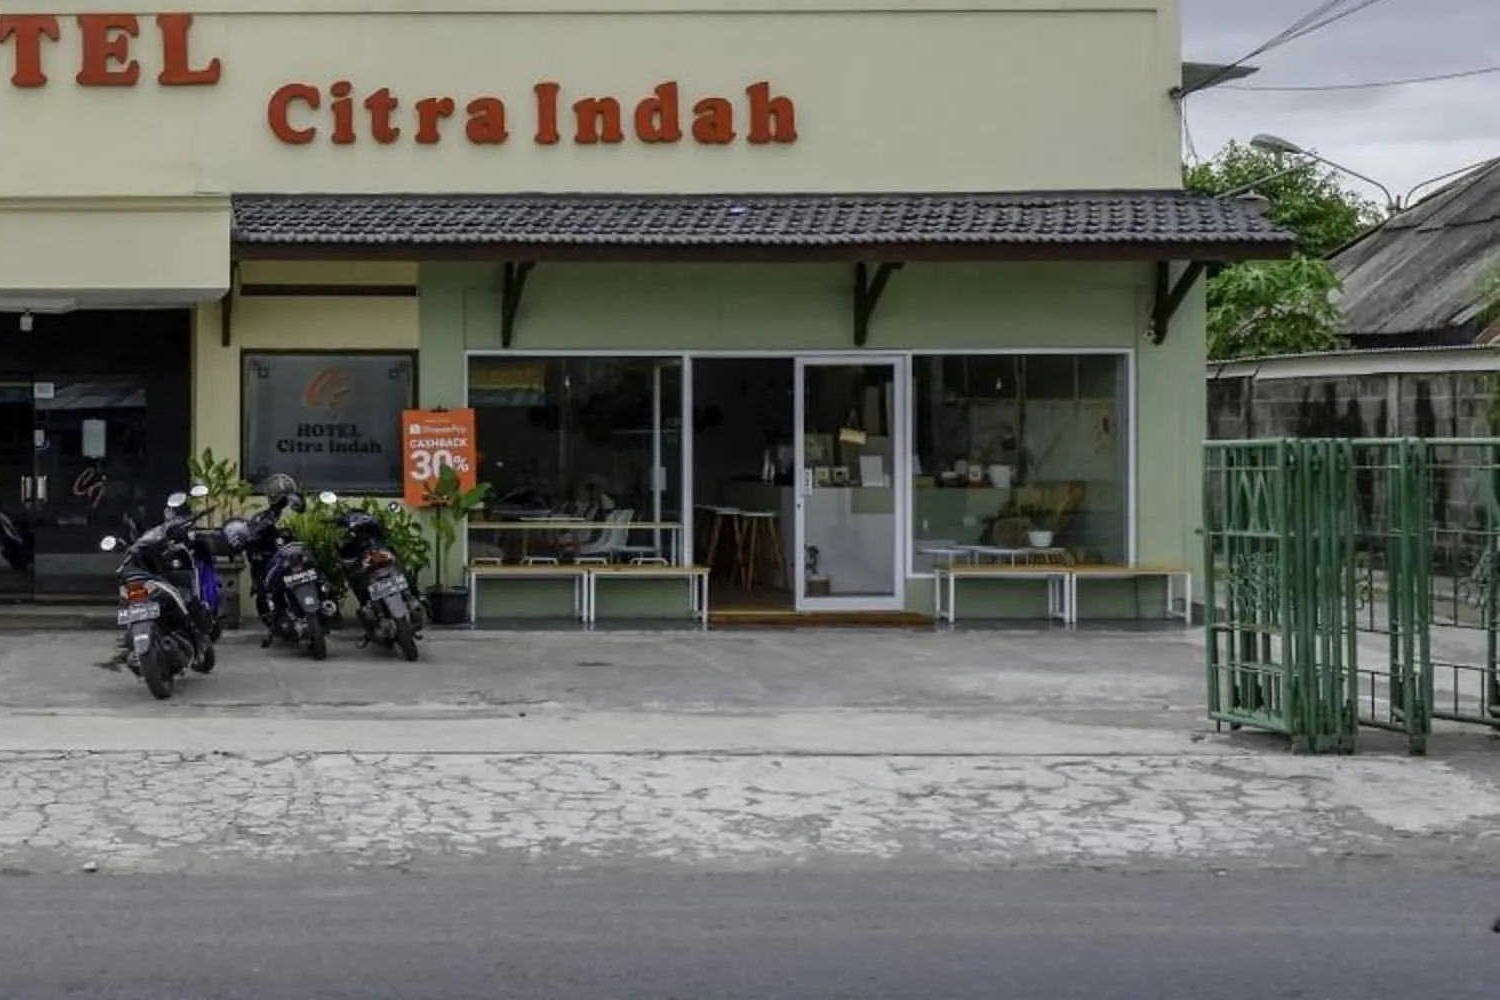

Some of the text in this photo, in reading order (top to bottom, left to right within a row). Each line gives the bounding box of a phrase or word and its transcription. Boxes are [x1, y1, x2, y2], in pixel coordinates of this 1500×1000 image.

[268, 81, 798, 146] Citra Indah
[297, 423, 362, 438] HOTEL
[276, 439, 382, 454] Citra Indah
